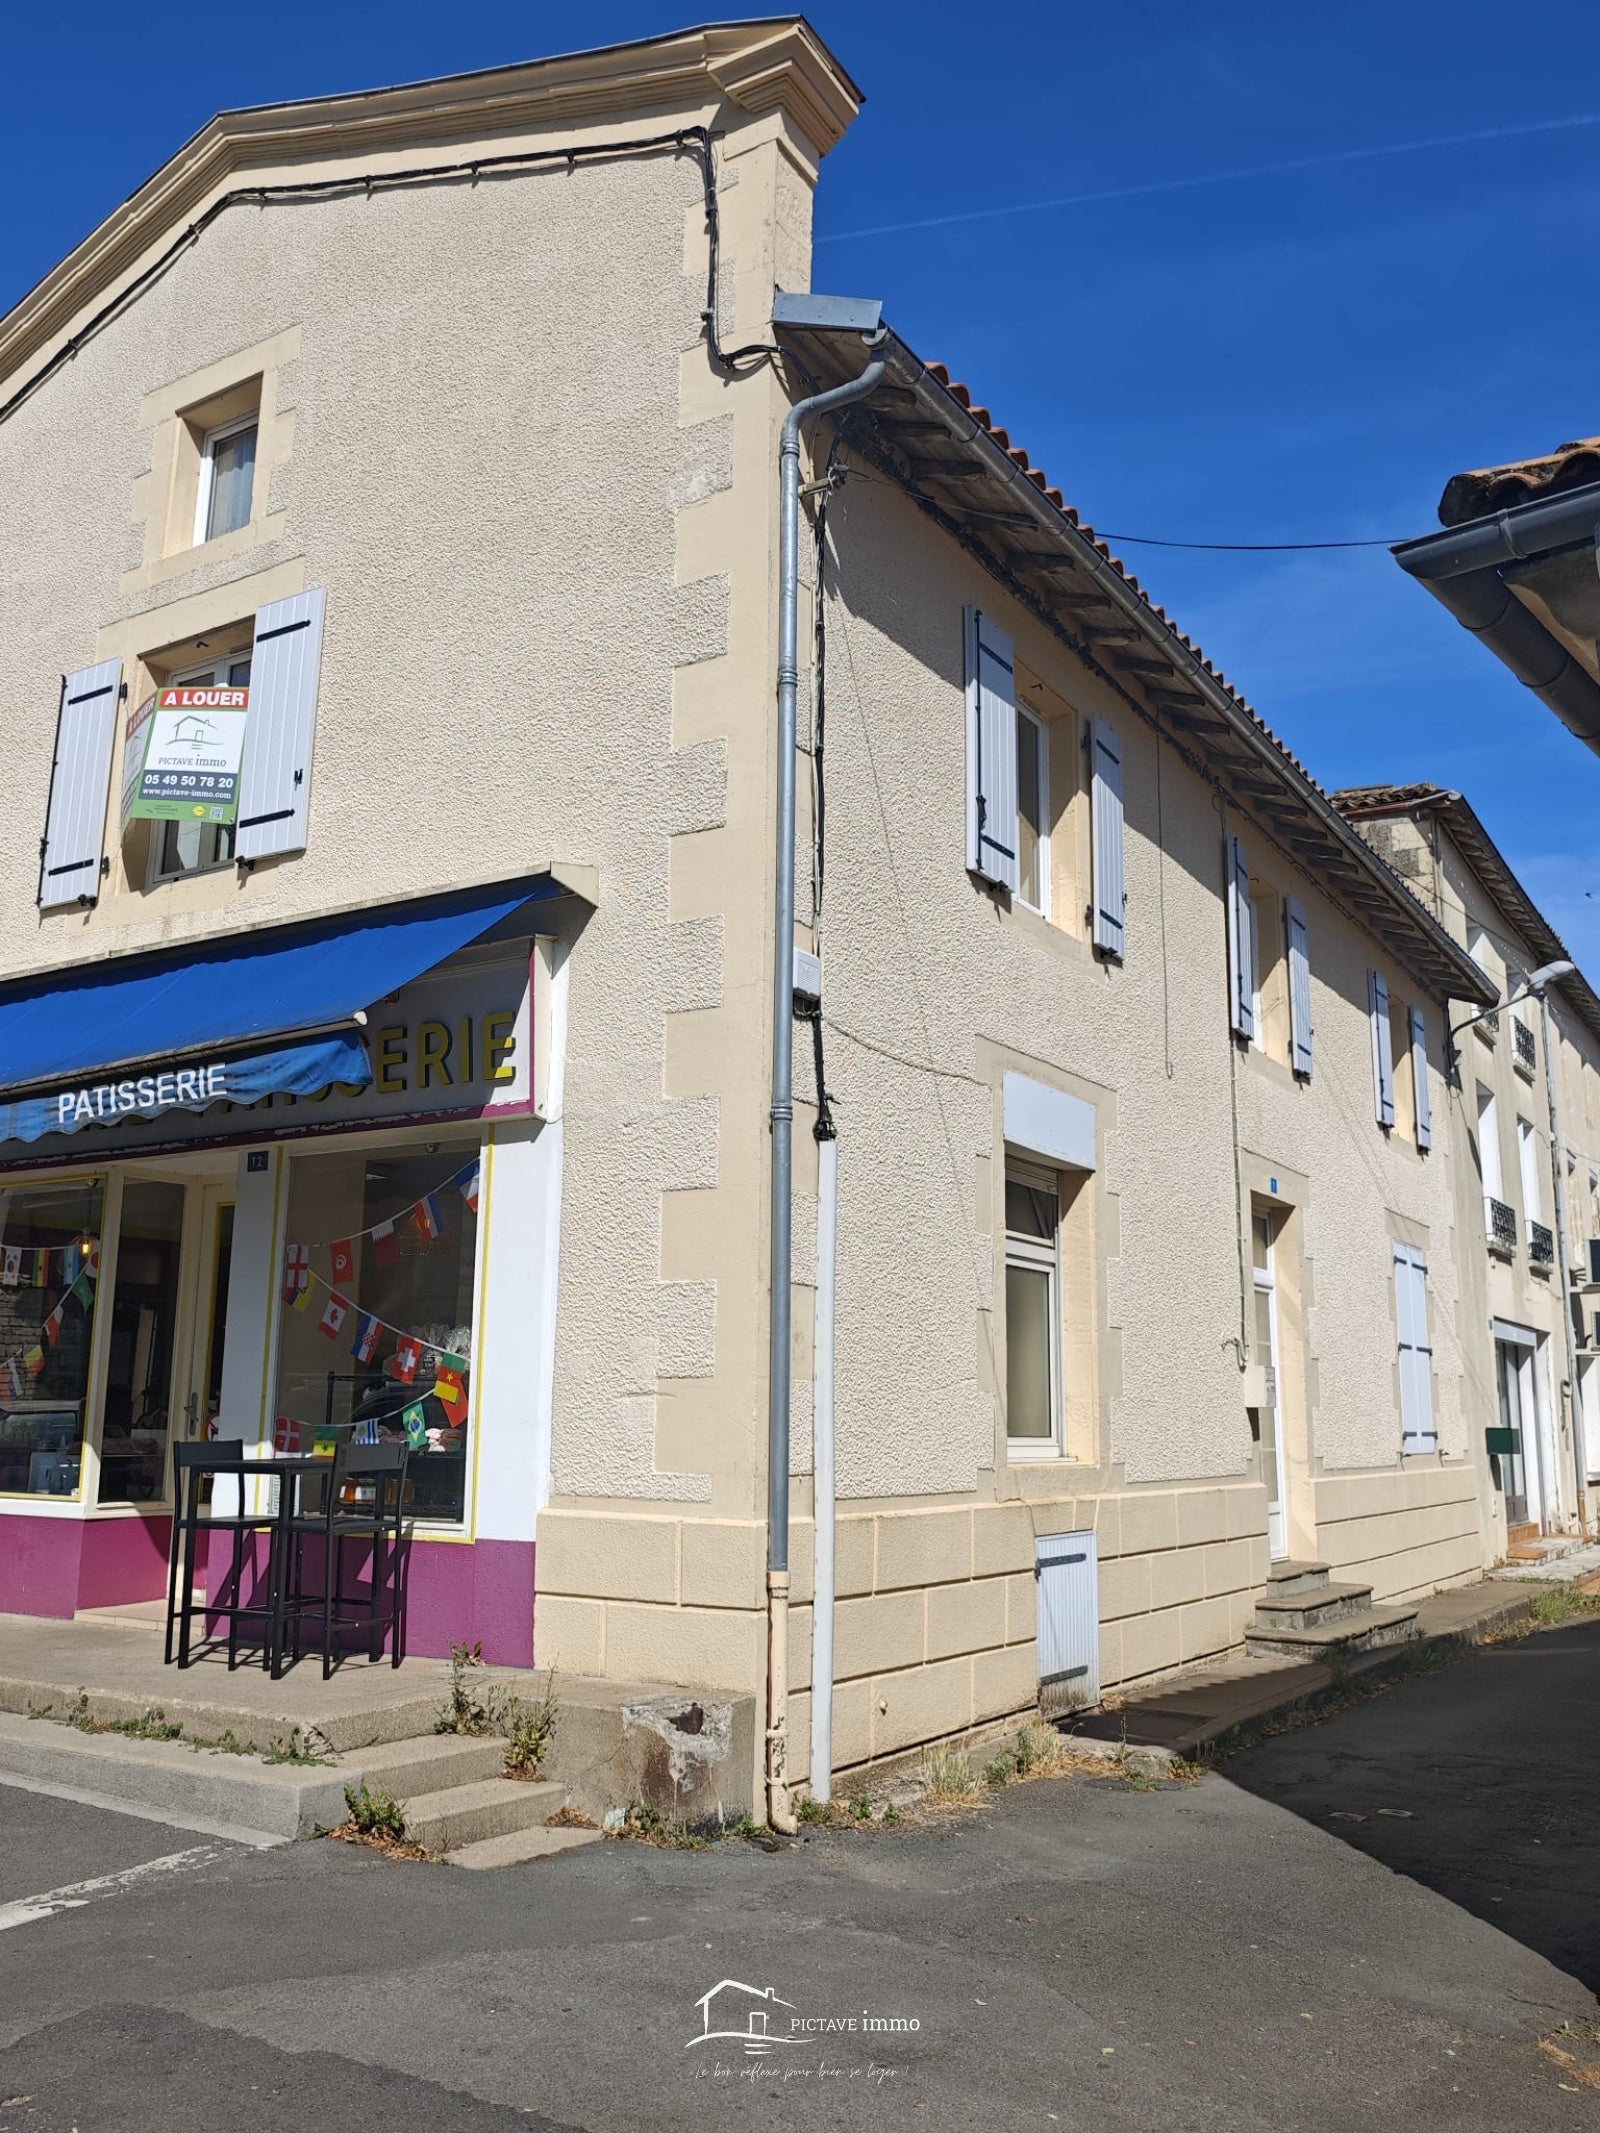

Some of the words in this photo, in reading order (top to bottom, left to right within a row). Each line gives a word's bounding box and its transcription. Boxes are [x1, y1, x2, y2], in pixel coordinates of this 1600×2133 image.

[164, 692, 177, 705] A
[181, 692, 244, 706] LOUER
[158, 757, 194, 766] PICTAVE
[195, 754, 227, 767] immo
[144, 774, 160, 785] 05
[162, 775, 178, 785] 49
[180, 776, 196, 786] 50
[199, 777, 215, 787] 78
[218, 778, 234, 789] 20
[142, 788, 232, 798] www.pictave-immo.com
[58, 1063, 227, 1124] PATISSERIE
[252, 1156, 264, 1168] 12
